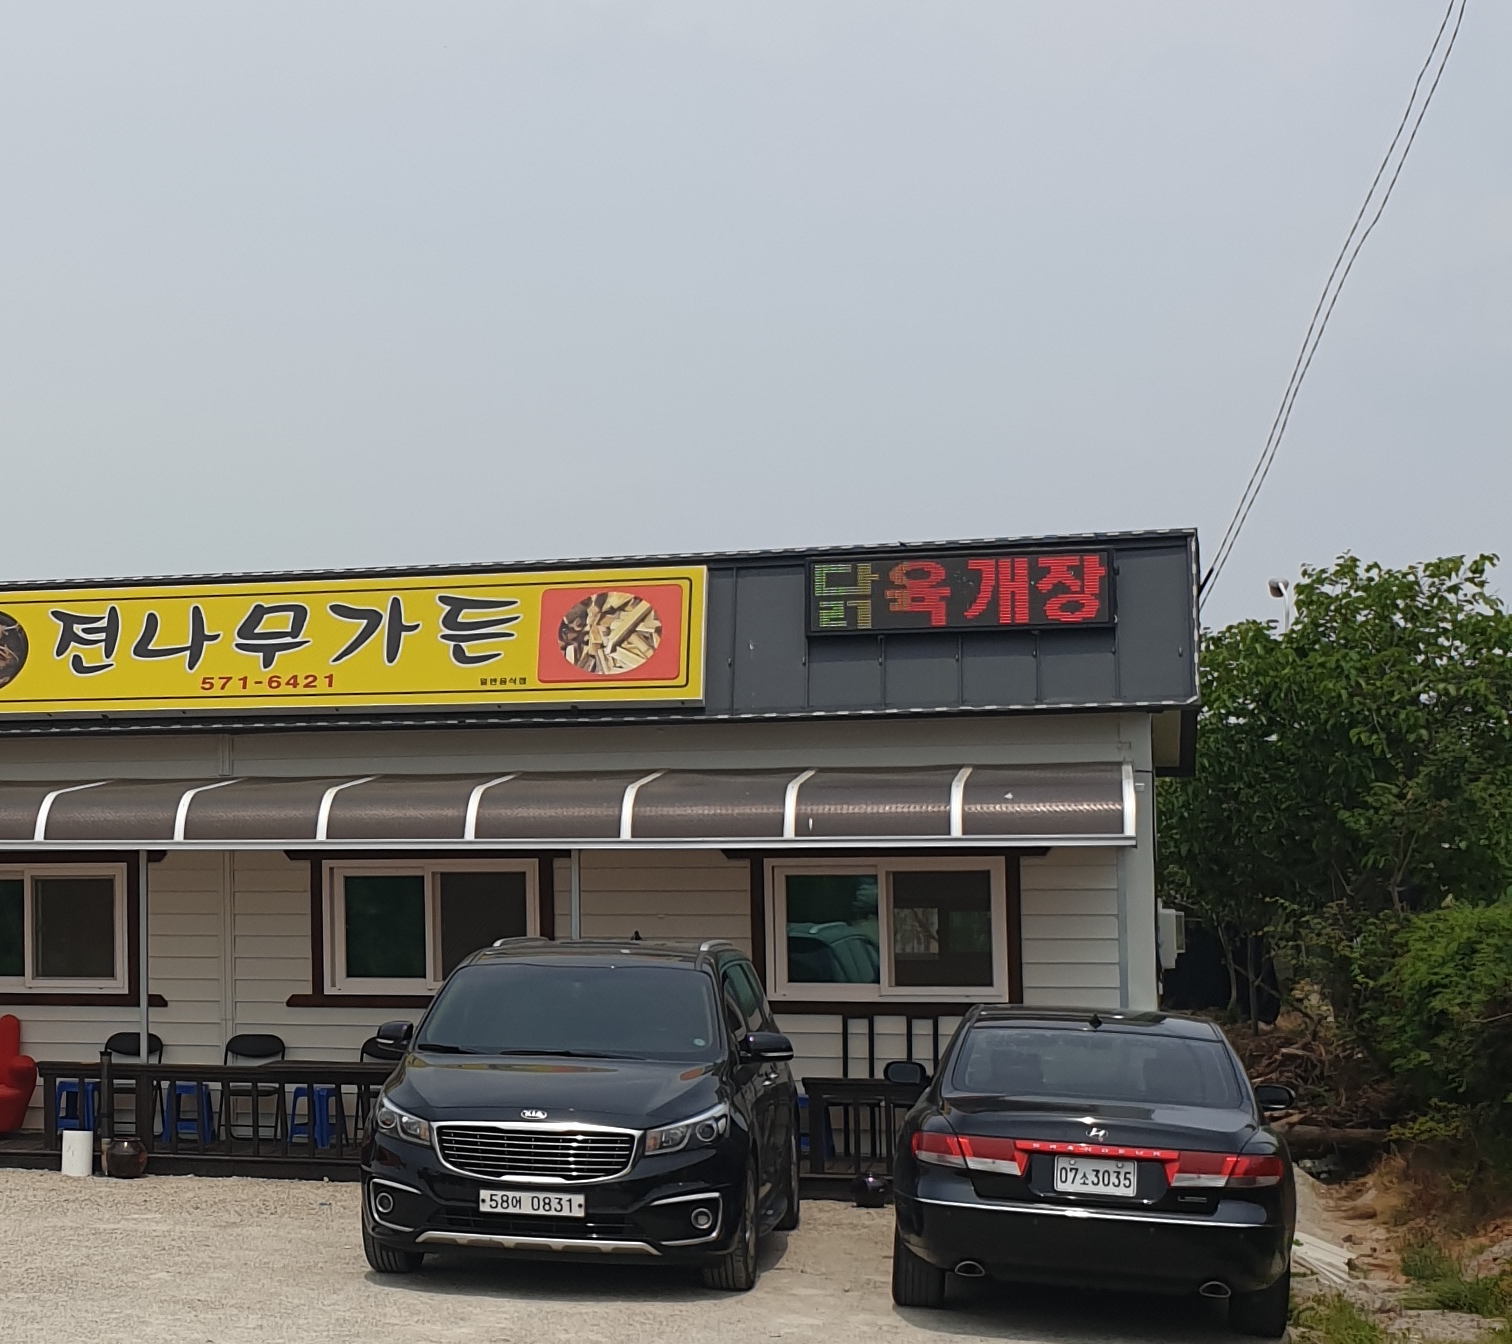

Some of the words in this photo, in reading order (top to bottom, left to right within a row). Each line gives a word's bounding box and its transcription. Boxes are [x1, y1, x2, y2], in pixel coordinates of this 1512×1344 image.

[813, 555, 1107, 629] 닭육개장
[49, 594, 523, 675] 전나무가든
[200, 673, 335, 691] 571-6421
[521, 1109, 547, 1119] KIA
[531, 1195, 573, 1214] 0831
